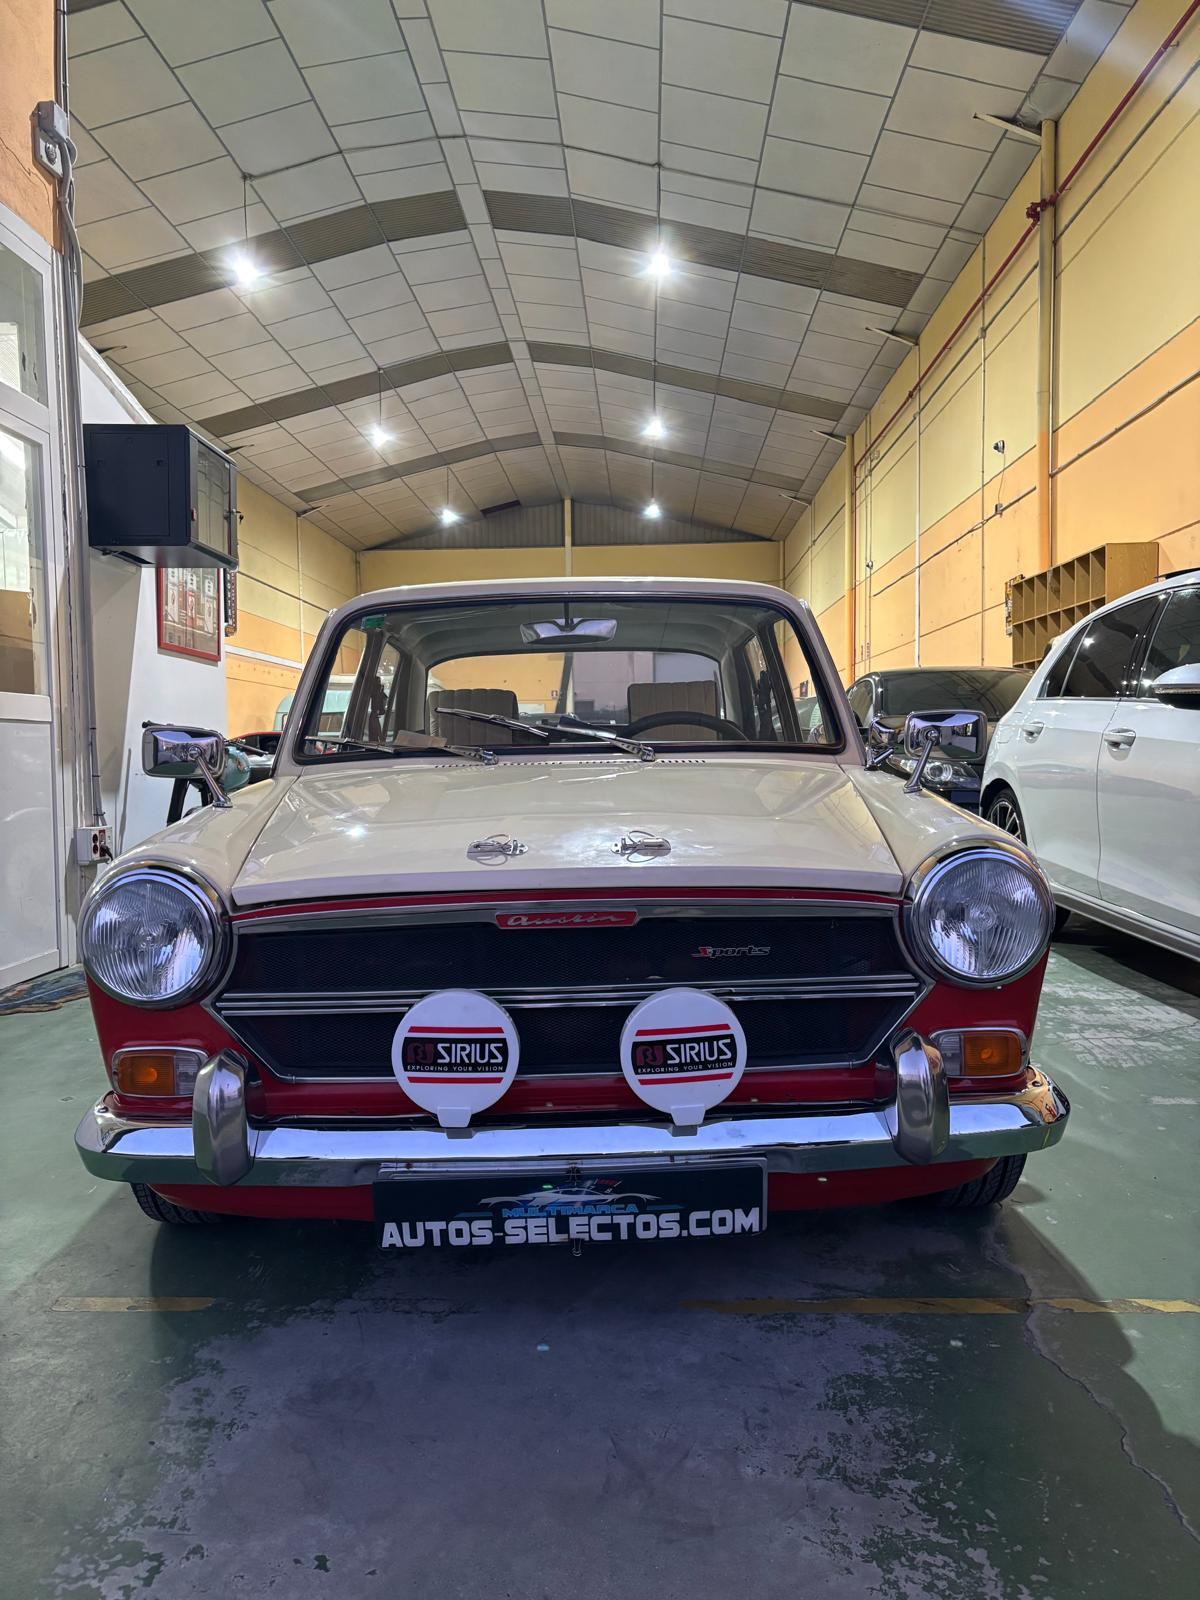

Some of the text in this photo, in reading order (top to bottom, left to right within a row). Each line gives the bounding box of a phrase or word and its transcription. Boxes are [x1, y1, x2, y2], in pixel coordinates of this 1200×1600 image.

[691, 945, 771, 959] Sports
[436, 1043, 503, 1064] SIRIUS
[666, 1039, 732, 1064] SIRIUS
[407, 1064, 449, 1072] EXPLORING
[707, 1061, 733, 1069] VISION
[502, 1203, 639, 1218] MULTIMARCA
[381, 1207, 760, 1248] AUTOS-SELECTOS.COM
